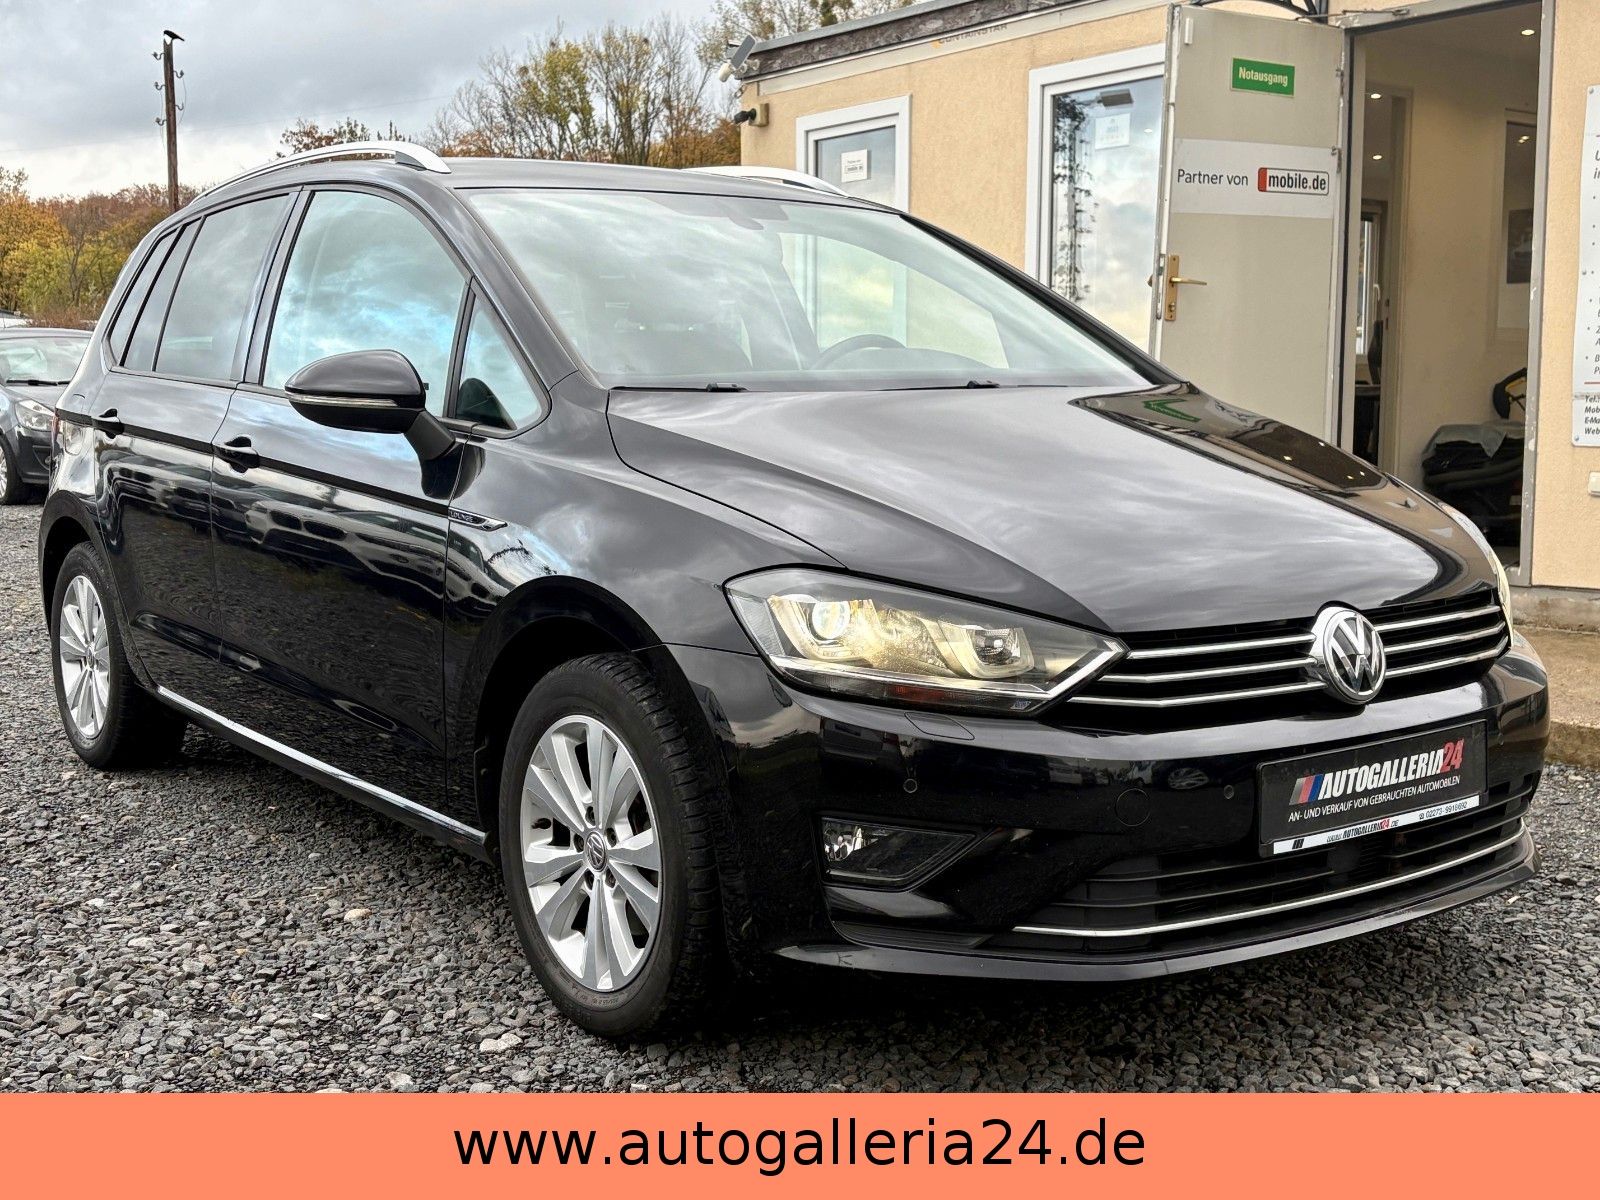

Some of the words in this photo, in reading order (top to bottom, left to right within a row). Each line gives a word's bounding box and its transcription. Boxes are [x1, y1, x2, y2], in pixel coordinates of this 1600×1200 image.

[1238, 66, 1289, 87] Notausgang
[1177, 168, 1224, 185] Partner
[1226, 174, 1249, 186] von
[1268, 173, 1327, 191] mobile.de
[1318, 738, 1465, 801] AUTOGALLERIA24
[1288, 810, 1303, 822] AN-
[1303, 807, 1321, 820] UND
[1321, 800, 1353, 816] VERKAUF
[1353, 796, 1370, 809] VON
[1369, 785, 1417, 806] GEBRAUCHTEN
[1416, 775, 1461, 795] AUTOMOBILEN
